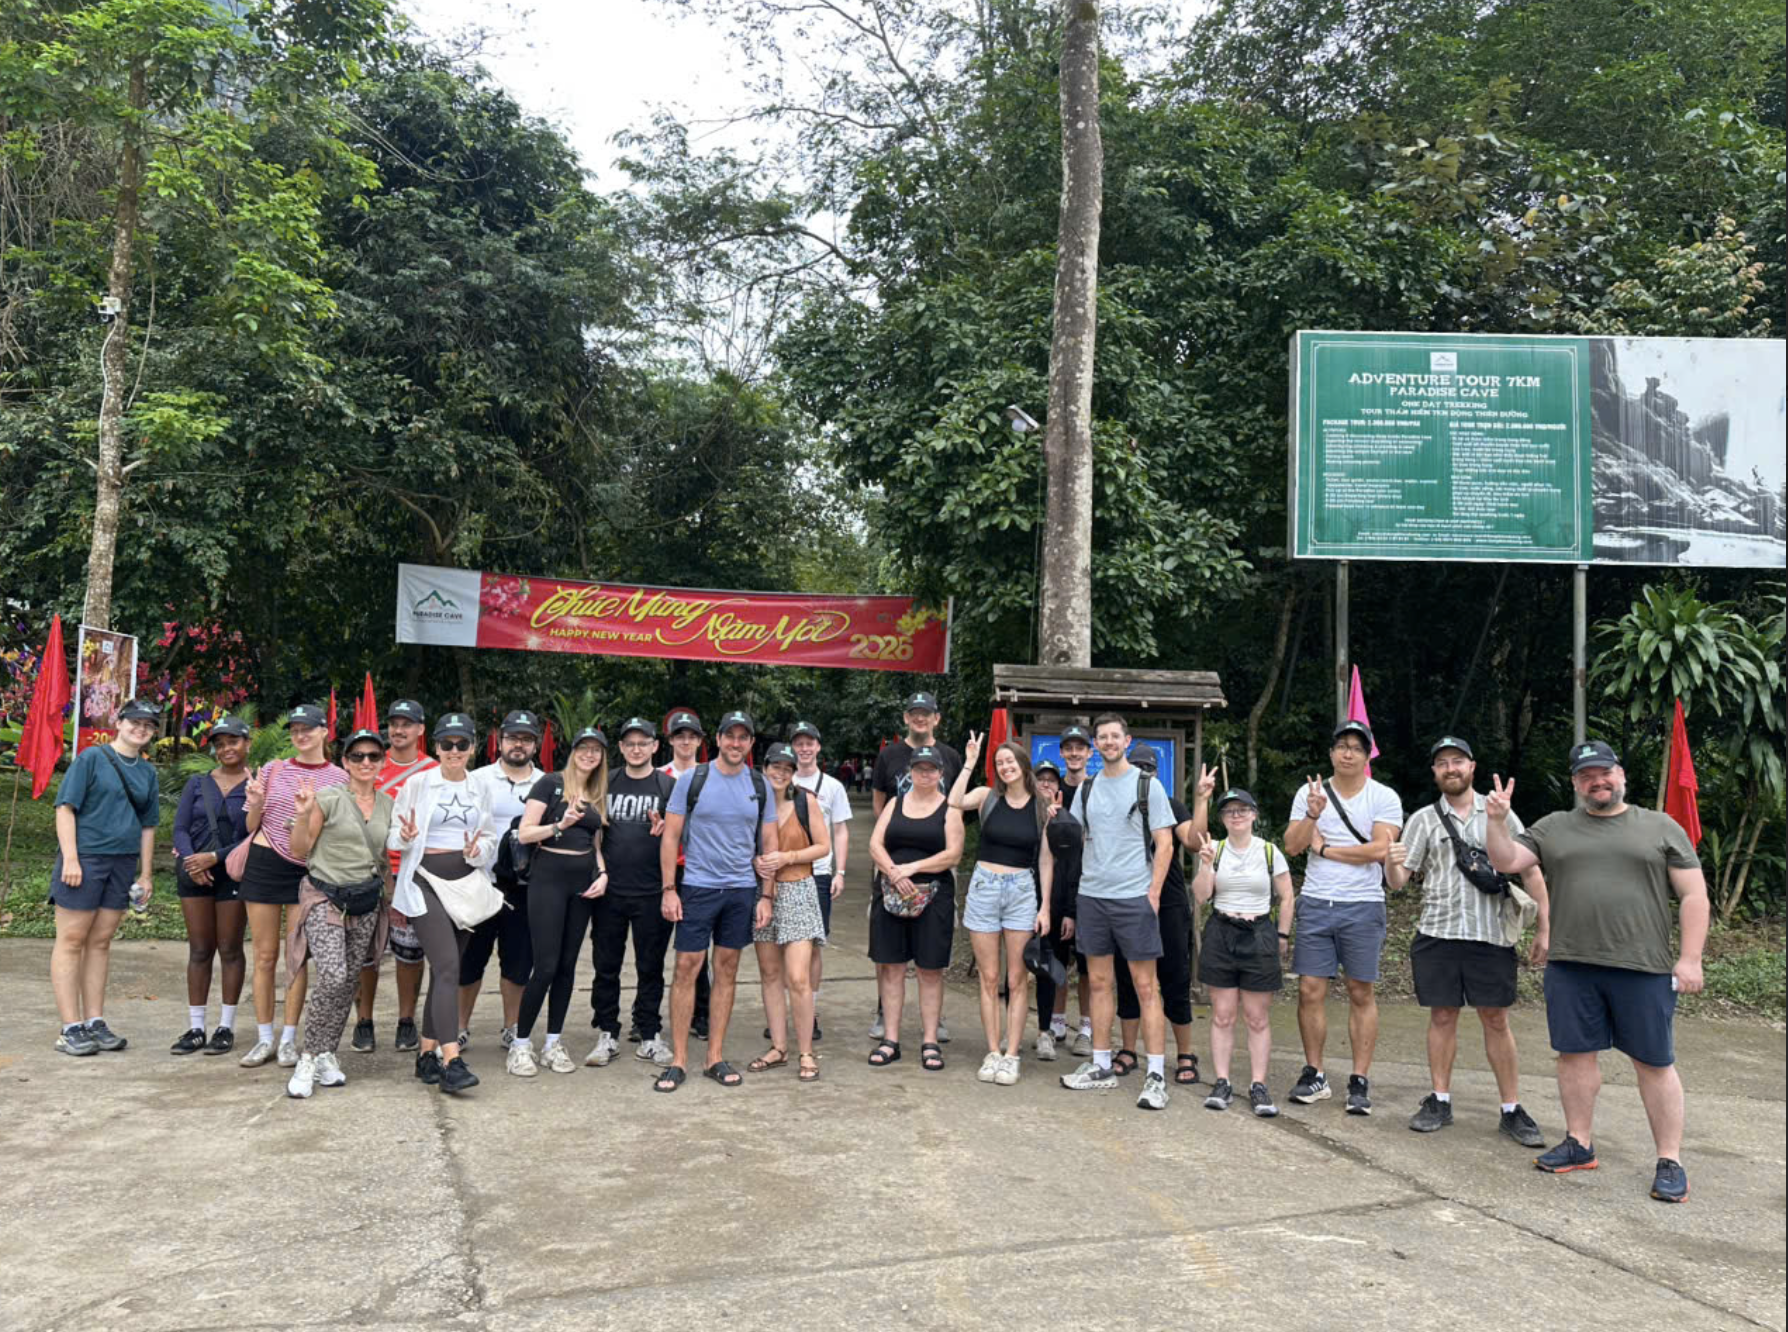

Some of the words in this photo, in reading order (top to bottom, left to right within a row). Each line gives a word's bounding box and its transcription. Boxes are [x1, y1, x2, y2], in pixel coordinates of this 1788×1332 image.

[1348, 373, 1450, 386] ADVENTURE
[1455, 374, 1501, 386] TOUR
[1506, 376, 1541, 387] 7KM
[1390, 387, 1456, 397] PARADISE
[1460, 388, 1499, 397] CAVE
[550, 628, 590, 639] HAPPY
[592, 631, 620, 641] NEW
[623, 633, 653, 643] YEAR
[849, 634, 914, 661] 2026
[606, 794, 660, 821] MOIN
